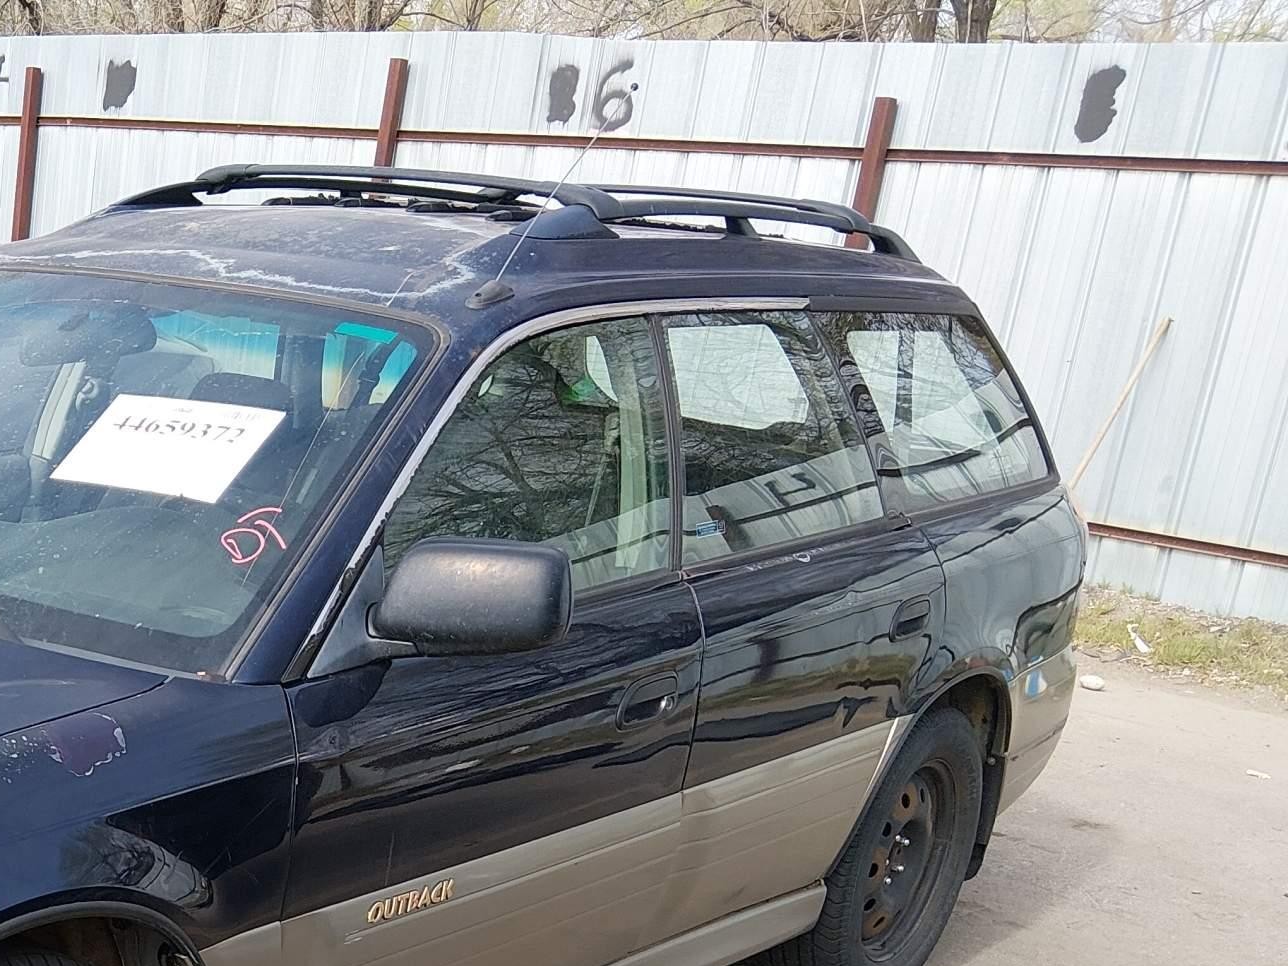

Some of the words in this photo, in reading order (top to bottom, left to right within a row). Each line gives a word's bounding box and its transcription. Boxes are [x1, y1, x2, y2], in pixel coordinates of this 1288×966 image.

[593, 58, 634, 132] 6
[113, 415, 245, 443] 44659372
[367, 878, 456, 923] OUTBACK
